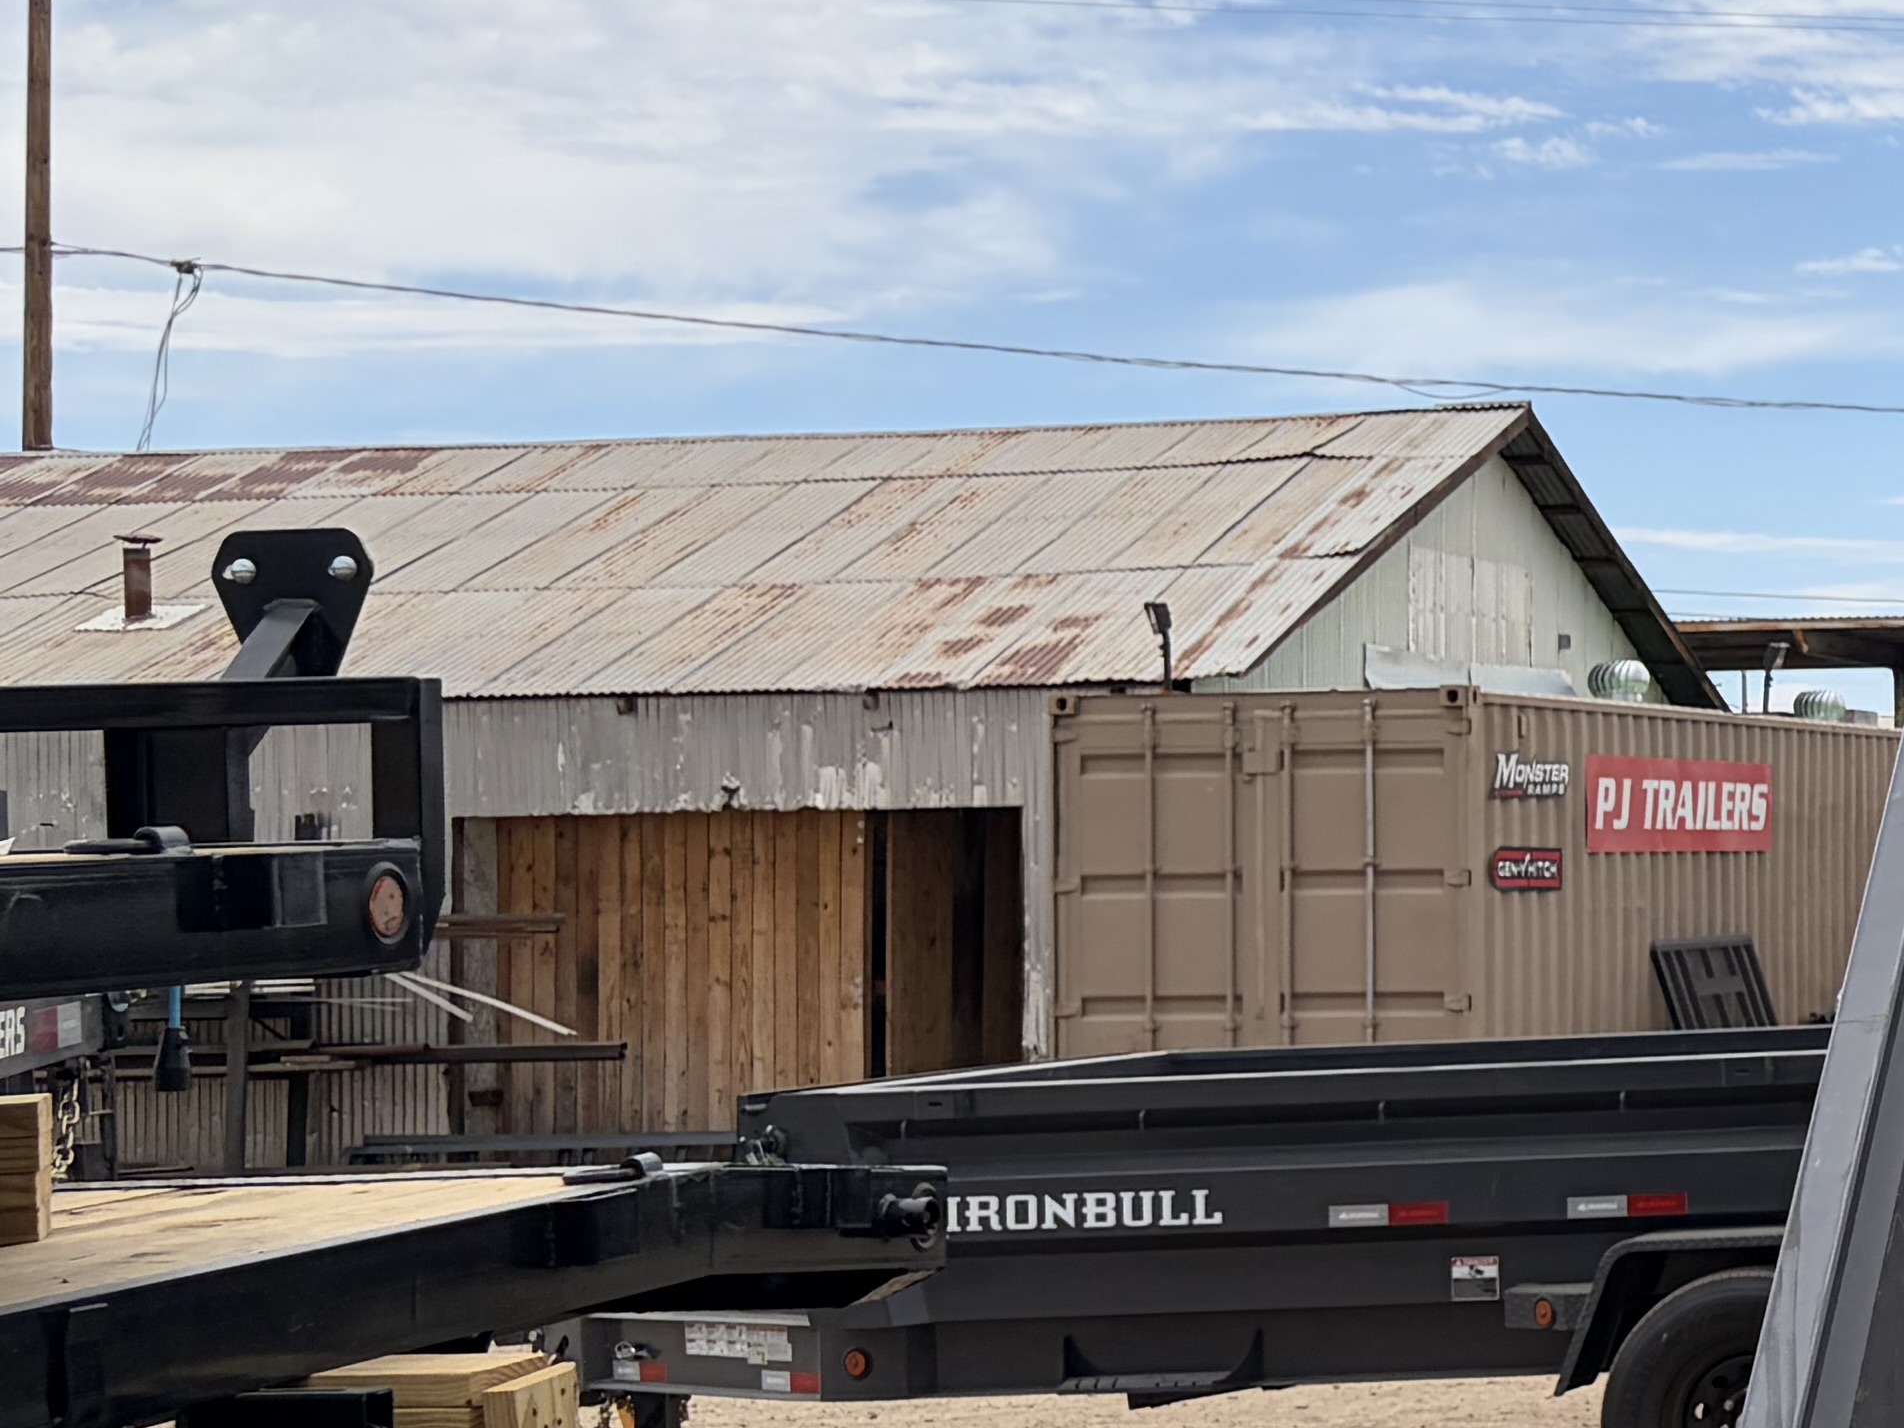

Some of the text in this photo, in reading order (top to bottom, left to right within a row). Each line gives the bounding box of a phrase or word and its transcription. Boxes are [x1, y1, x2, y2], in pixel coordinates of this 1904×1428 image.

[1595, 777, 1768, 831] PJ TRAILERS
[947, 1189, 1223, 1232] IRONBULL
